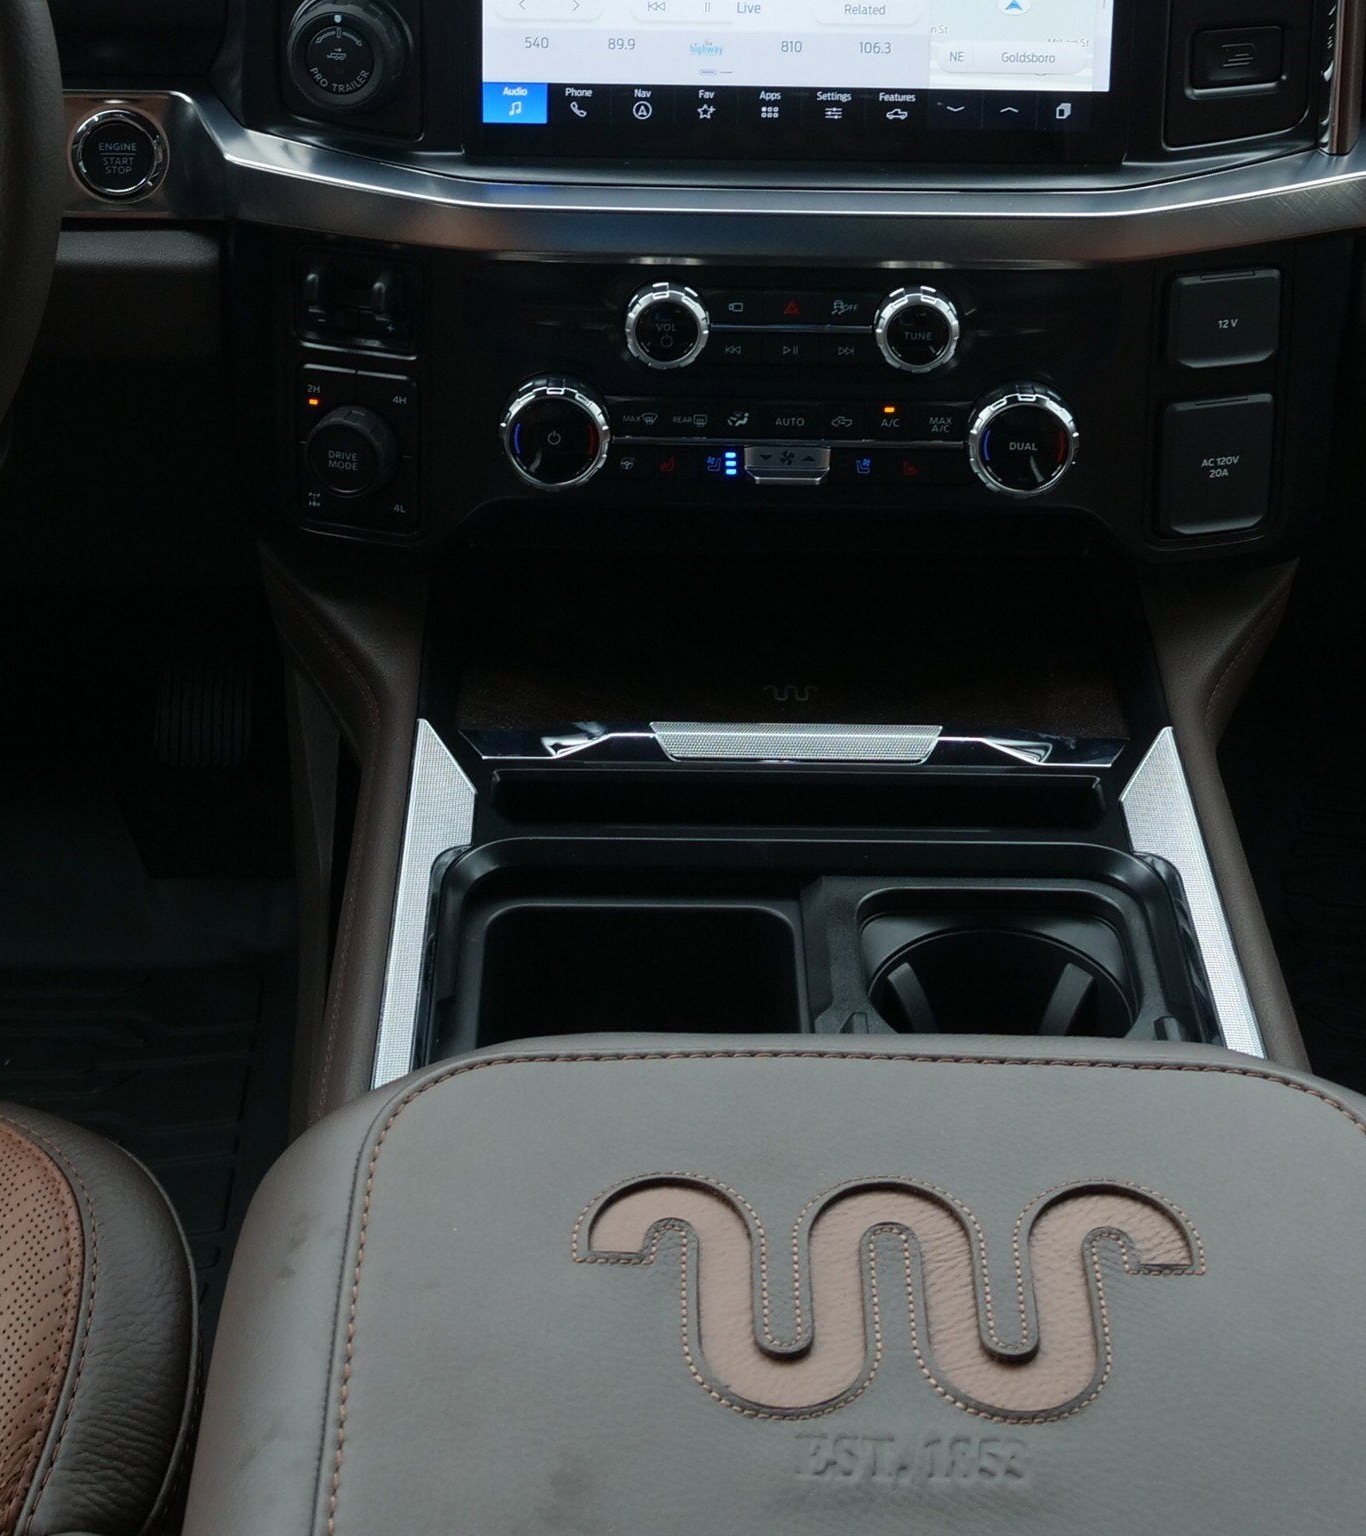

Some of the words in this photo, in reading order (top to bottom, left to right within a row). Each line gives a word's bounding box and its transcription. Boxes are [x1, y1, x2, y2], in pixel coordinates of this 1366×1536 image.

[737, 2, 761, 14] Live
[844, 3, 886, 16] Related
[524, 36, 549, 49] 540
[608, 37, 635, 50] 89.9
[781, 40, 803, 53] 810
[859, 41, 892, 54] 106.3
[949, 51, 965, 62] NE
[1001, 52, 1056, 64] Goldsboro
[309, 66, 329, 88] PRO
[332, 69, 370, 93] TRAILER
[503, 86, 528, 97] Audio
[565, 87, 593, 98] Phone
[634, 88, 652, 98] Nav
[698, 89, 715, 99] Fav
[759, 90, 781, 101] Apps
[817, 91, 852, 102] Settings
[879, 92, 916, 102] Features
[98, 142, 137, 152] ENGINE
[102, 156, 135, 166] START
[104, 165, 132, 175] STOP
[655, 322, 678, 332] VOL
[1218, 319, 1230, 329] 12
[1230, 318, 1238, 328] V
[903, 331, 933, 341] TUNE
[307, 384, 320, 394] 2H
[392, 395, 407, 405] 4H
[622, 414, 641, 423] MAX
[672, 415, 693, 424] REAR
[775, 417, 805, 427] AUTO
[880, 417, 900, 429] A/C
[929, 416, 953, 426] MAX
[931, 424, 951, 434] A/C
[1009, 442, 1038, 452] DUAL
[327, 450, 359, 462] DRIVE
[1201, 457, 1216, 468] AC
[1217, 455, 1240, 466] 120V
[328, 459, 359, 471] MODE
[1209, 468, 1229, 478] 20A
